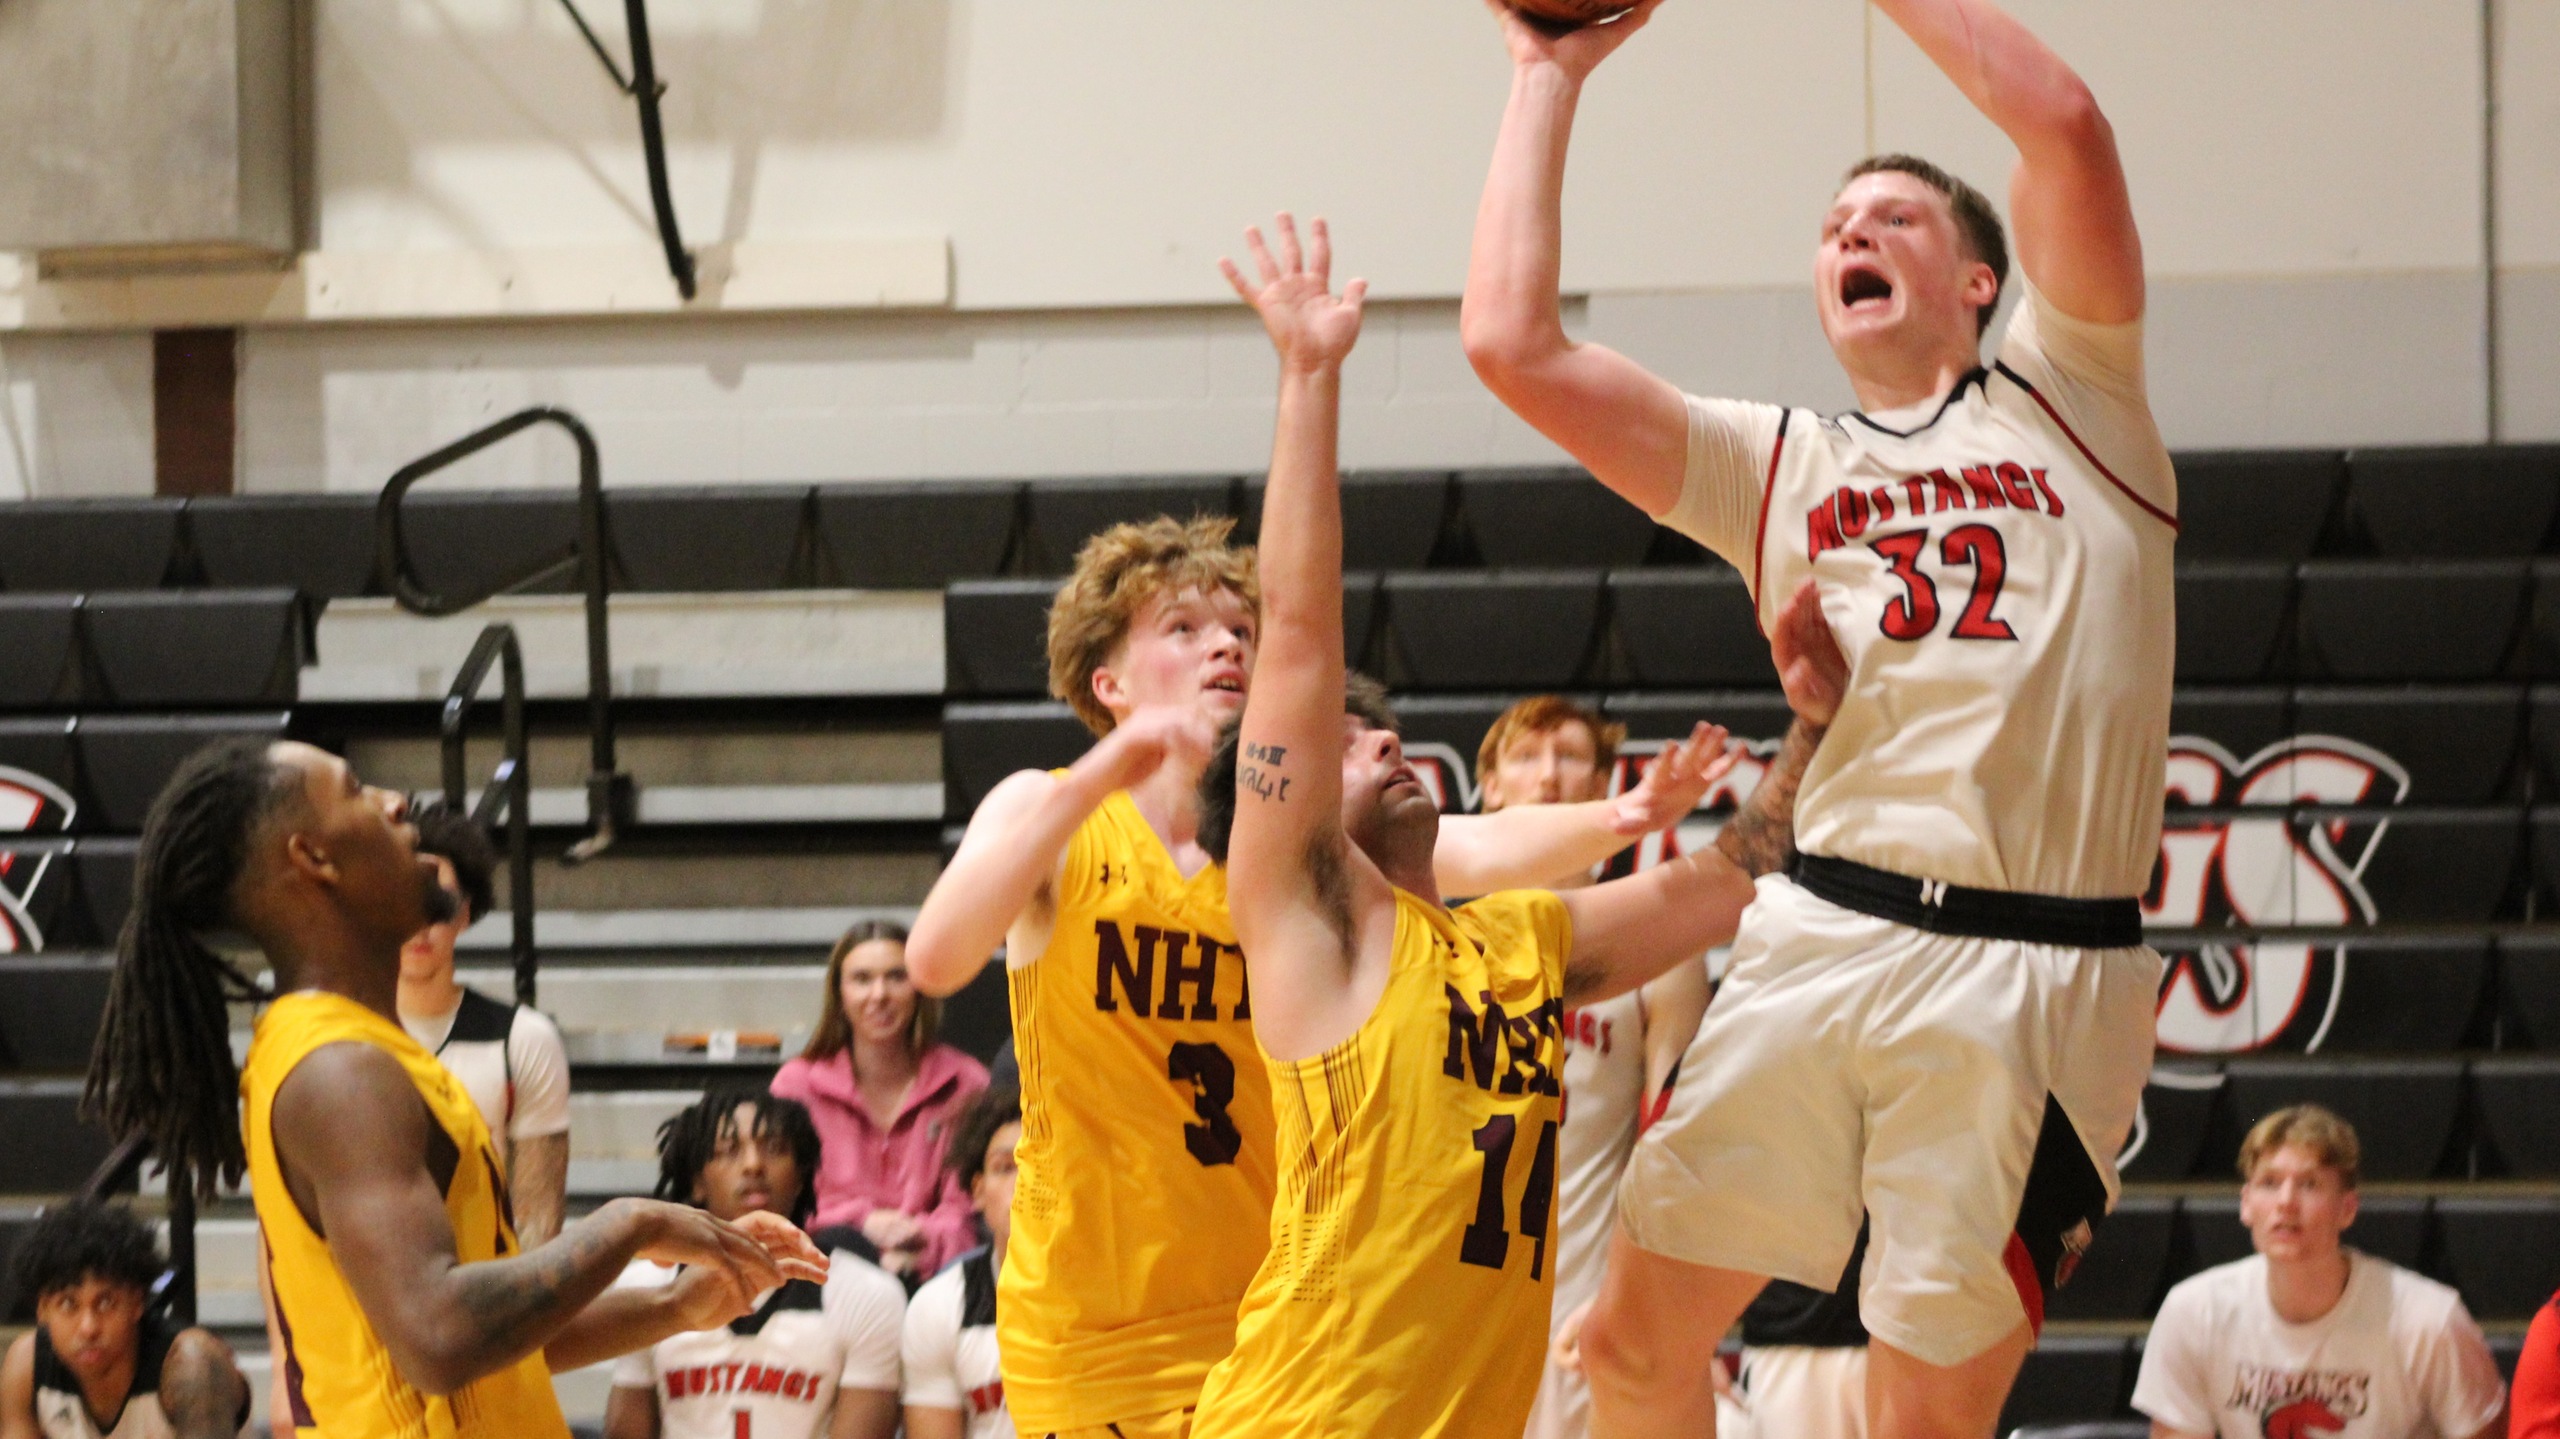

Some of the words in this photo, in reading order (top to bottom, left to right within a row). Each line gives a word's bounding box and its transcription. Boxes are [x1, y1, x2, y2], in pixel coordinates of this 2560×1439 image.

[1807, 461, 2065, 565] MUSTANGS
[1868, 523, 2019, 642] 32
[1168, 1039, 1242, 1167] 3
[1459, 1113, 1558, 1283] 14
[666, 1362, 823, 1403] MUSTANGS
